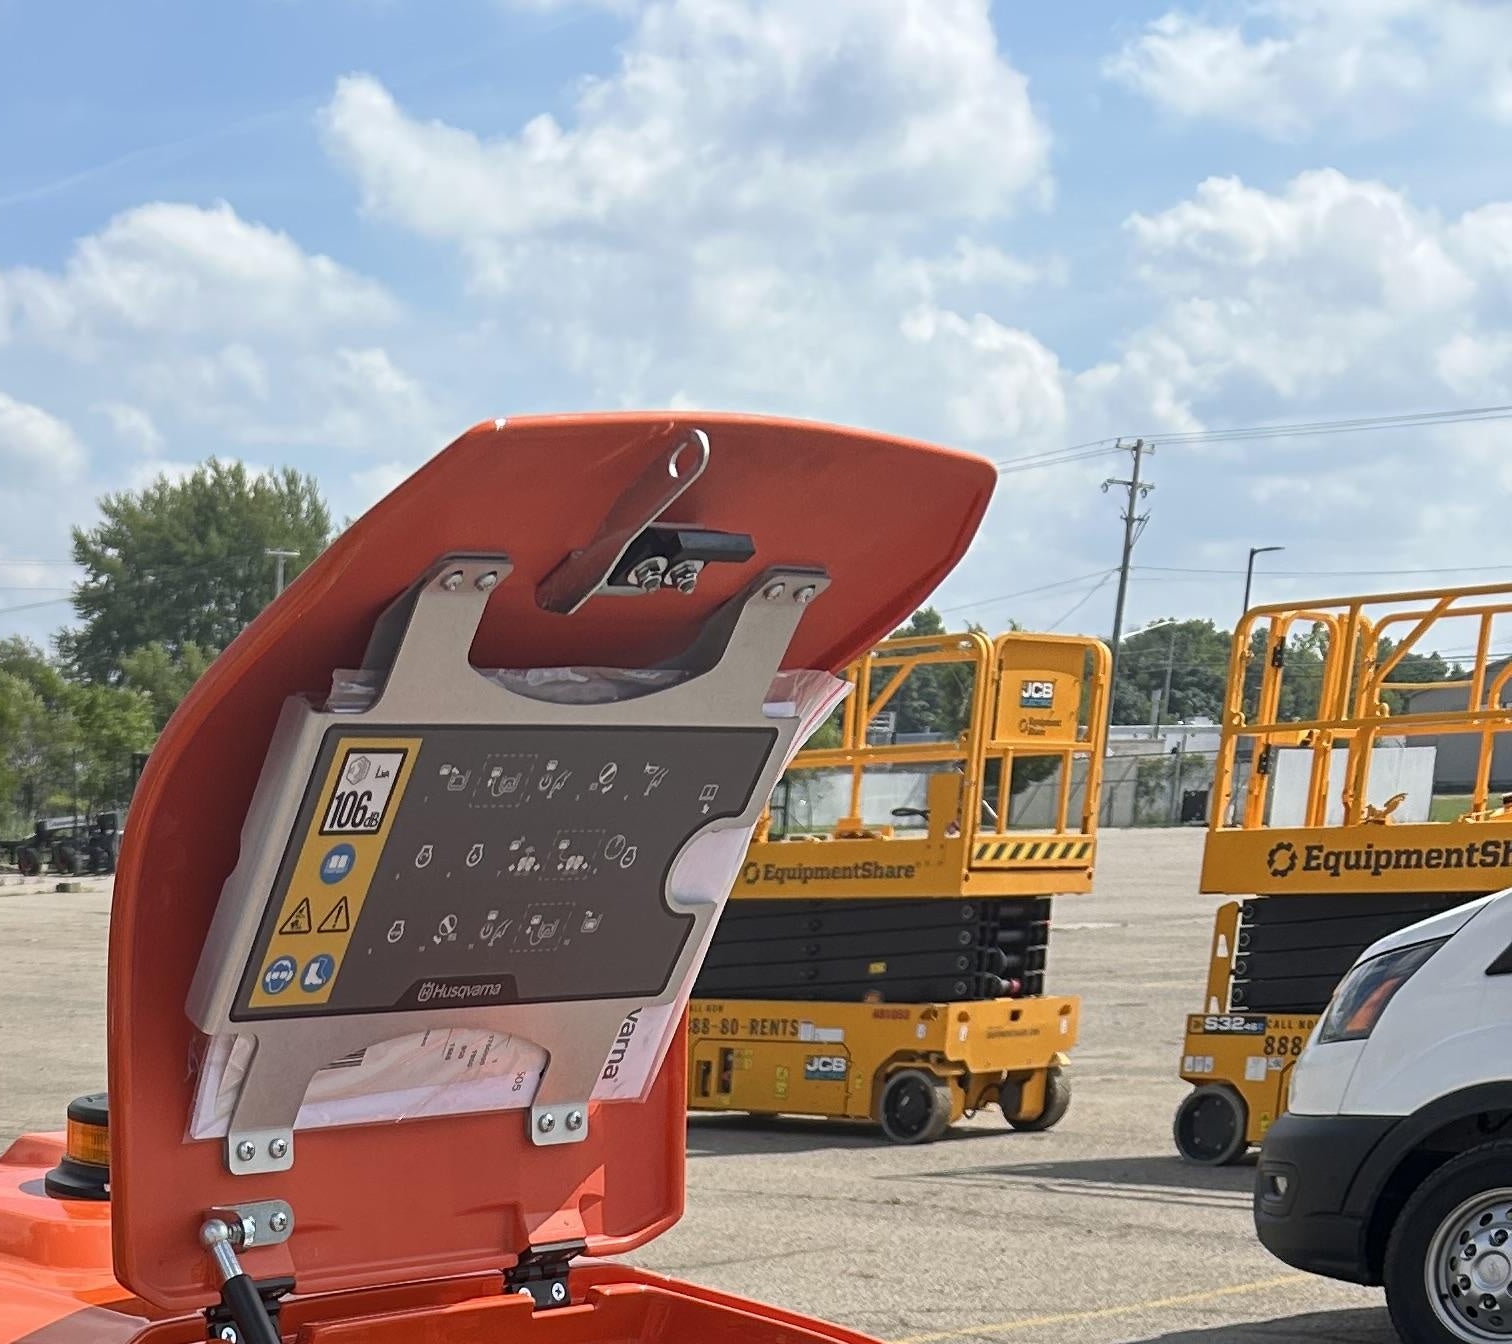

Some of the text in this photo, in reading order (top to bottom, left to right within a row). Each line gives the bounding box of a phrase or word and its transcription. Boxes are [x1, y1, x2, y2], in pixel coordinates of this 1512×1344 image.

[1022, 682, 1053, 698] JCB
[329, 790, 380, 828] 106 dB
[763, 861, 915, 884] EquipmentShare
[431, 983, 501, 999] Husqvarna
[806, 1057, 847, 1072] JCB
